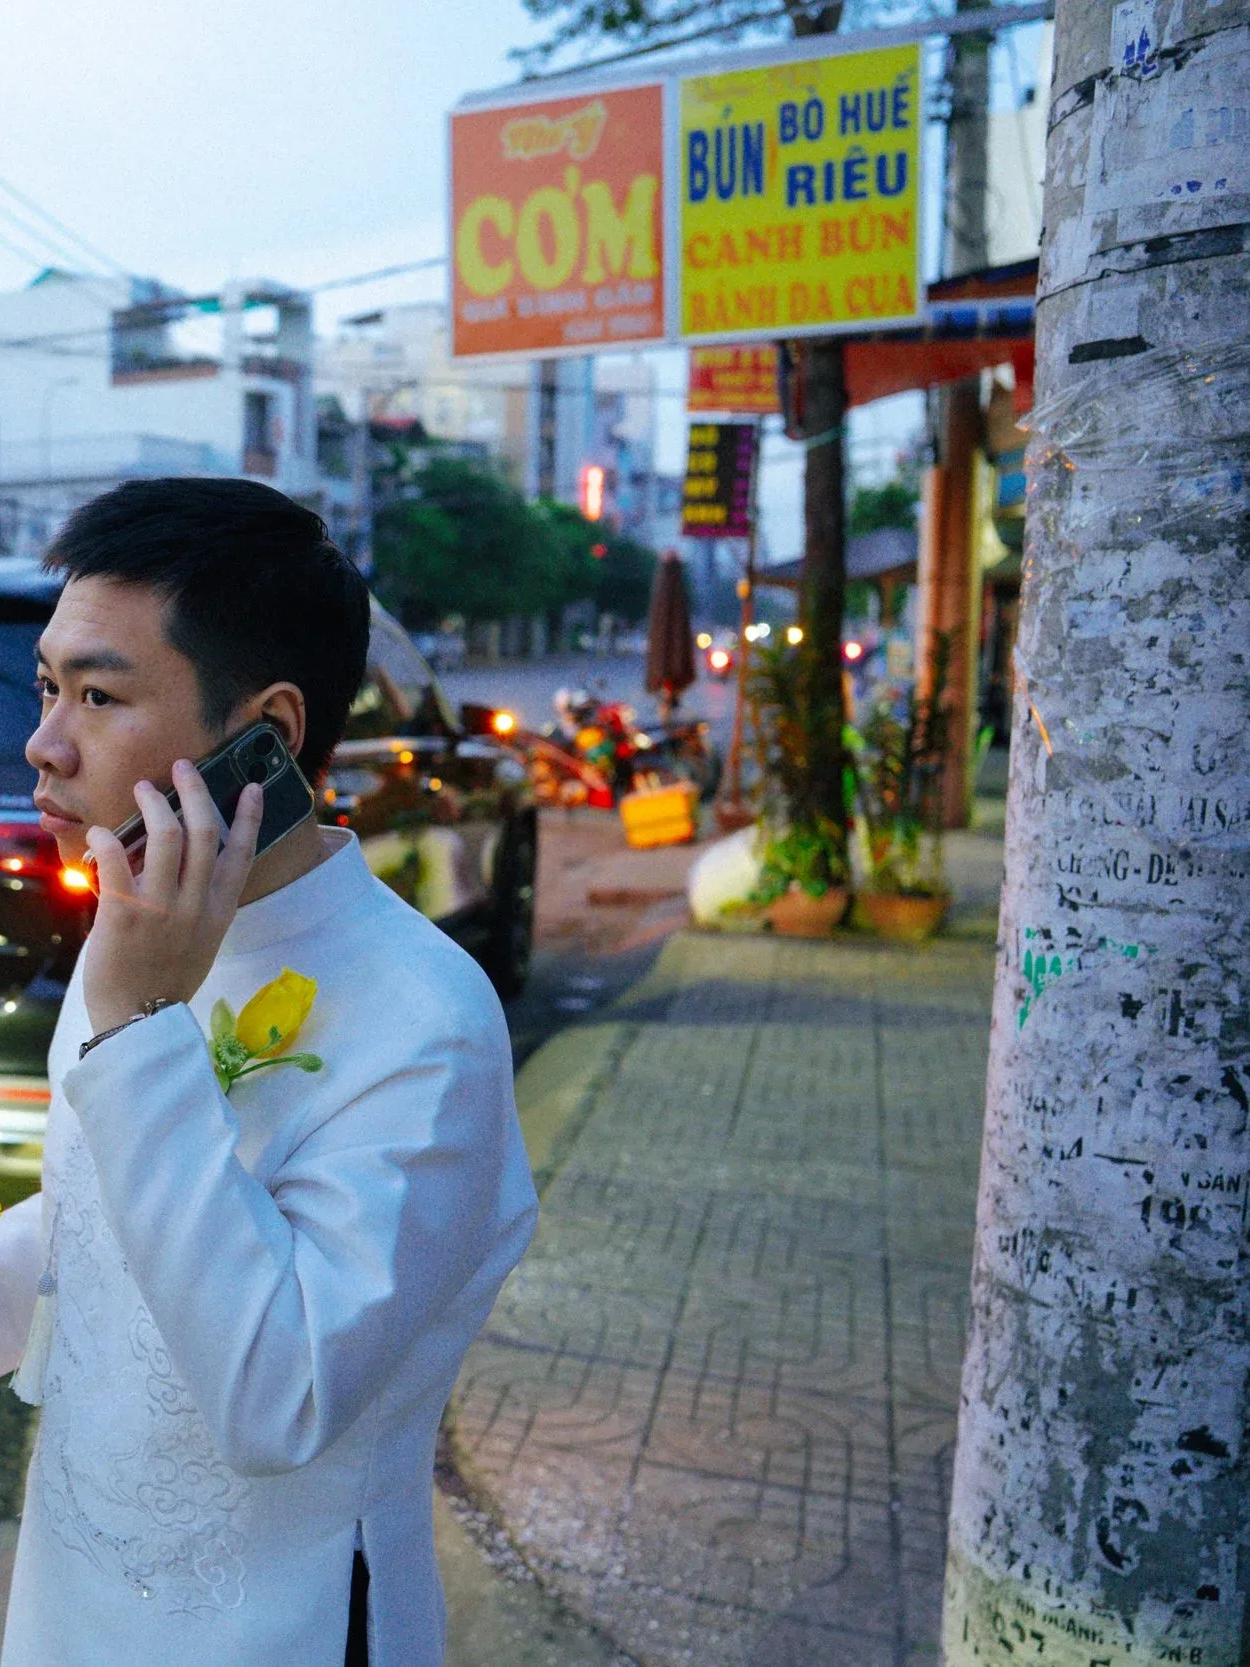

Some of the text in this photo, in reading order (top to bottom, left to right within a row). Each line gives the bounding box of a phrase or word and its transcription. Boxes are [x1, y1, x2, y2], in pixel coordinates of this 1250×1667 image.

[779, 86, 824, 144] BÒ
[839, 66, 915, 136] HUẾ
[688, 105, 764, 203] BÚN
[786, 145, 907, 207] RIÊU
[457, 164, 658, 296] CƠM
[687, 205, 912, 269] CANH BÚN
[690, 279, 777, 330] BÁNH
[846, 274, 915, 315] CUA
